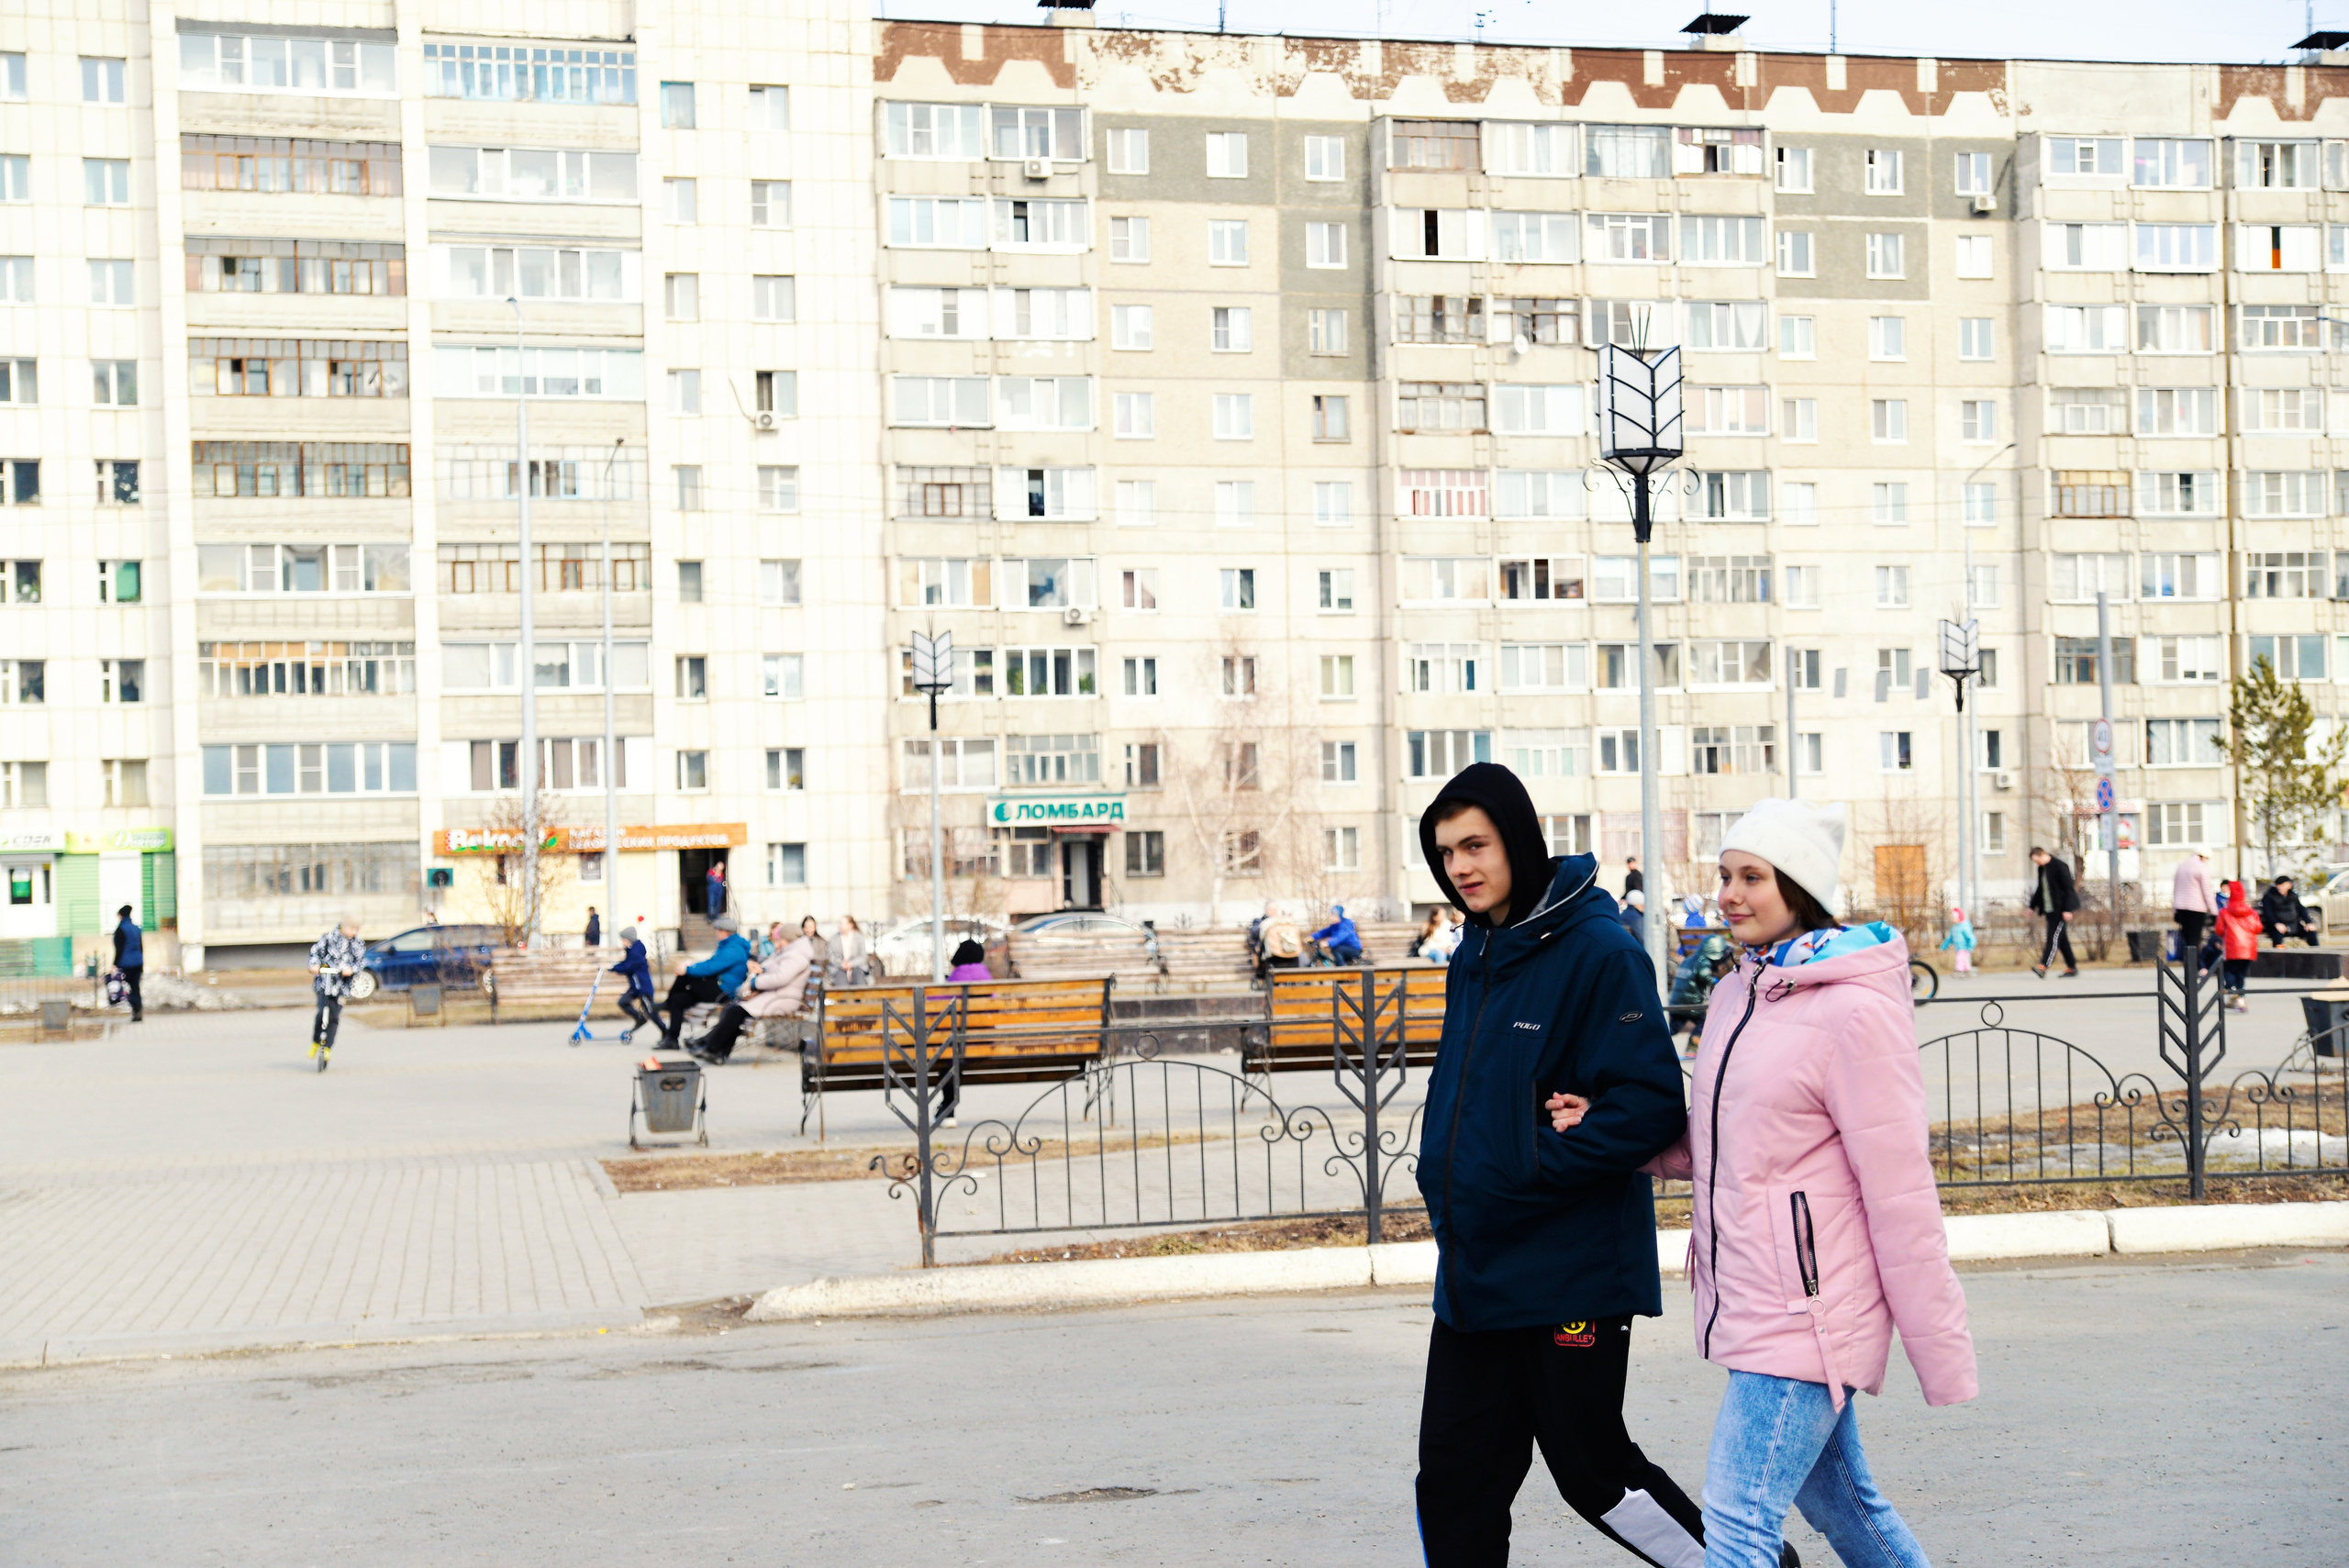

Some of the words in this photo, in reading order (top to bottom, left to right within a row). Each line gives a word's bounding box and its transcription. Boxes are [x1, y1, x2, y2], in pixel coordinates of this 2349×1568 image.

[1017, 803, 1124, 820] ЛОМБАРД
[656, 833, 729, 848] ПРОДУКТОВ
[1513, 1022, 1541, 1030] POGO
